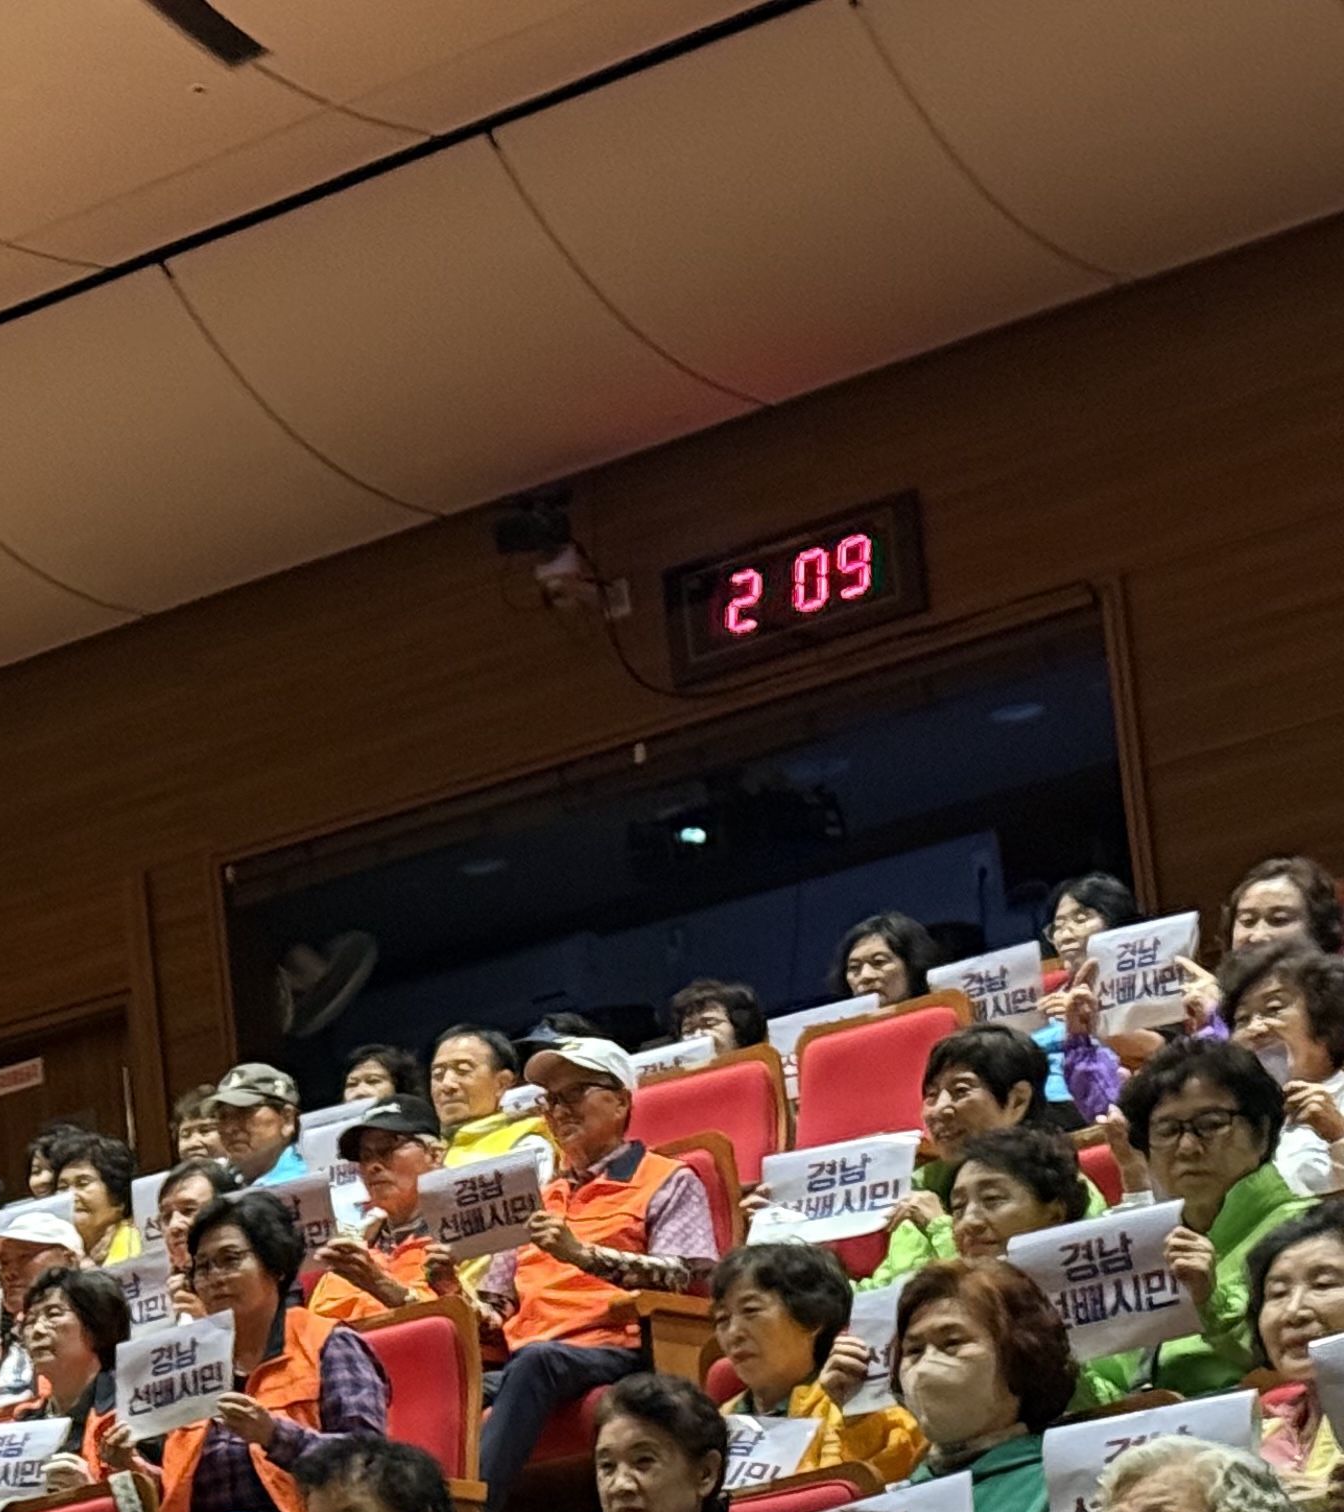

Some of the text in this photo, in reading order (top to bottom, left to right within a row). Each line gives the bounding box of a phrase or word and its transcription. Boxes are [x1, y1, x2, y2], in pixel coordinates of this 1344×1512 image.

[724, 533, 873, 636] 2 09
[1117, 937, 1161, 972] 경남
[962, 964, 1009, 995] 경남
[1098, 967, 1188, 1010] 선배시민
[454, 1169, 504, 1206] 경남
[808, 1153, 876, 1193] 경남
[439, 1194, 536, 1243] 선배시민
[1059, 1231, 1132, 1281] 경남
[150, 1337, 199, 1376] 경남
[129, 1361, 223, 1416] 선배시민
